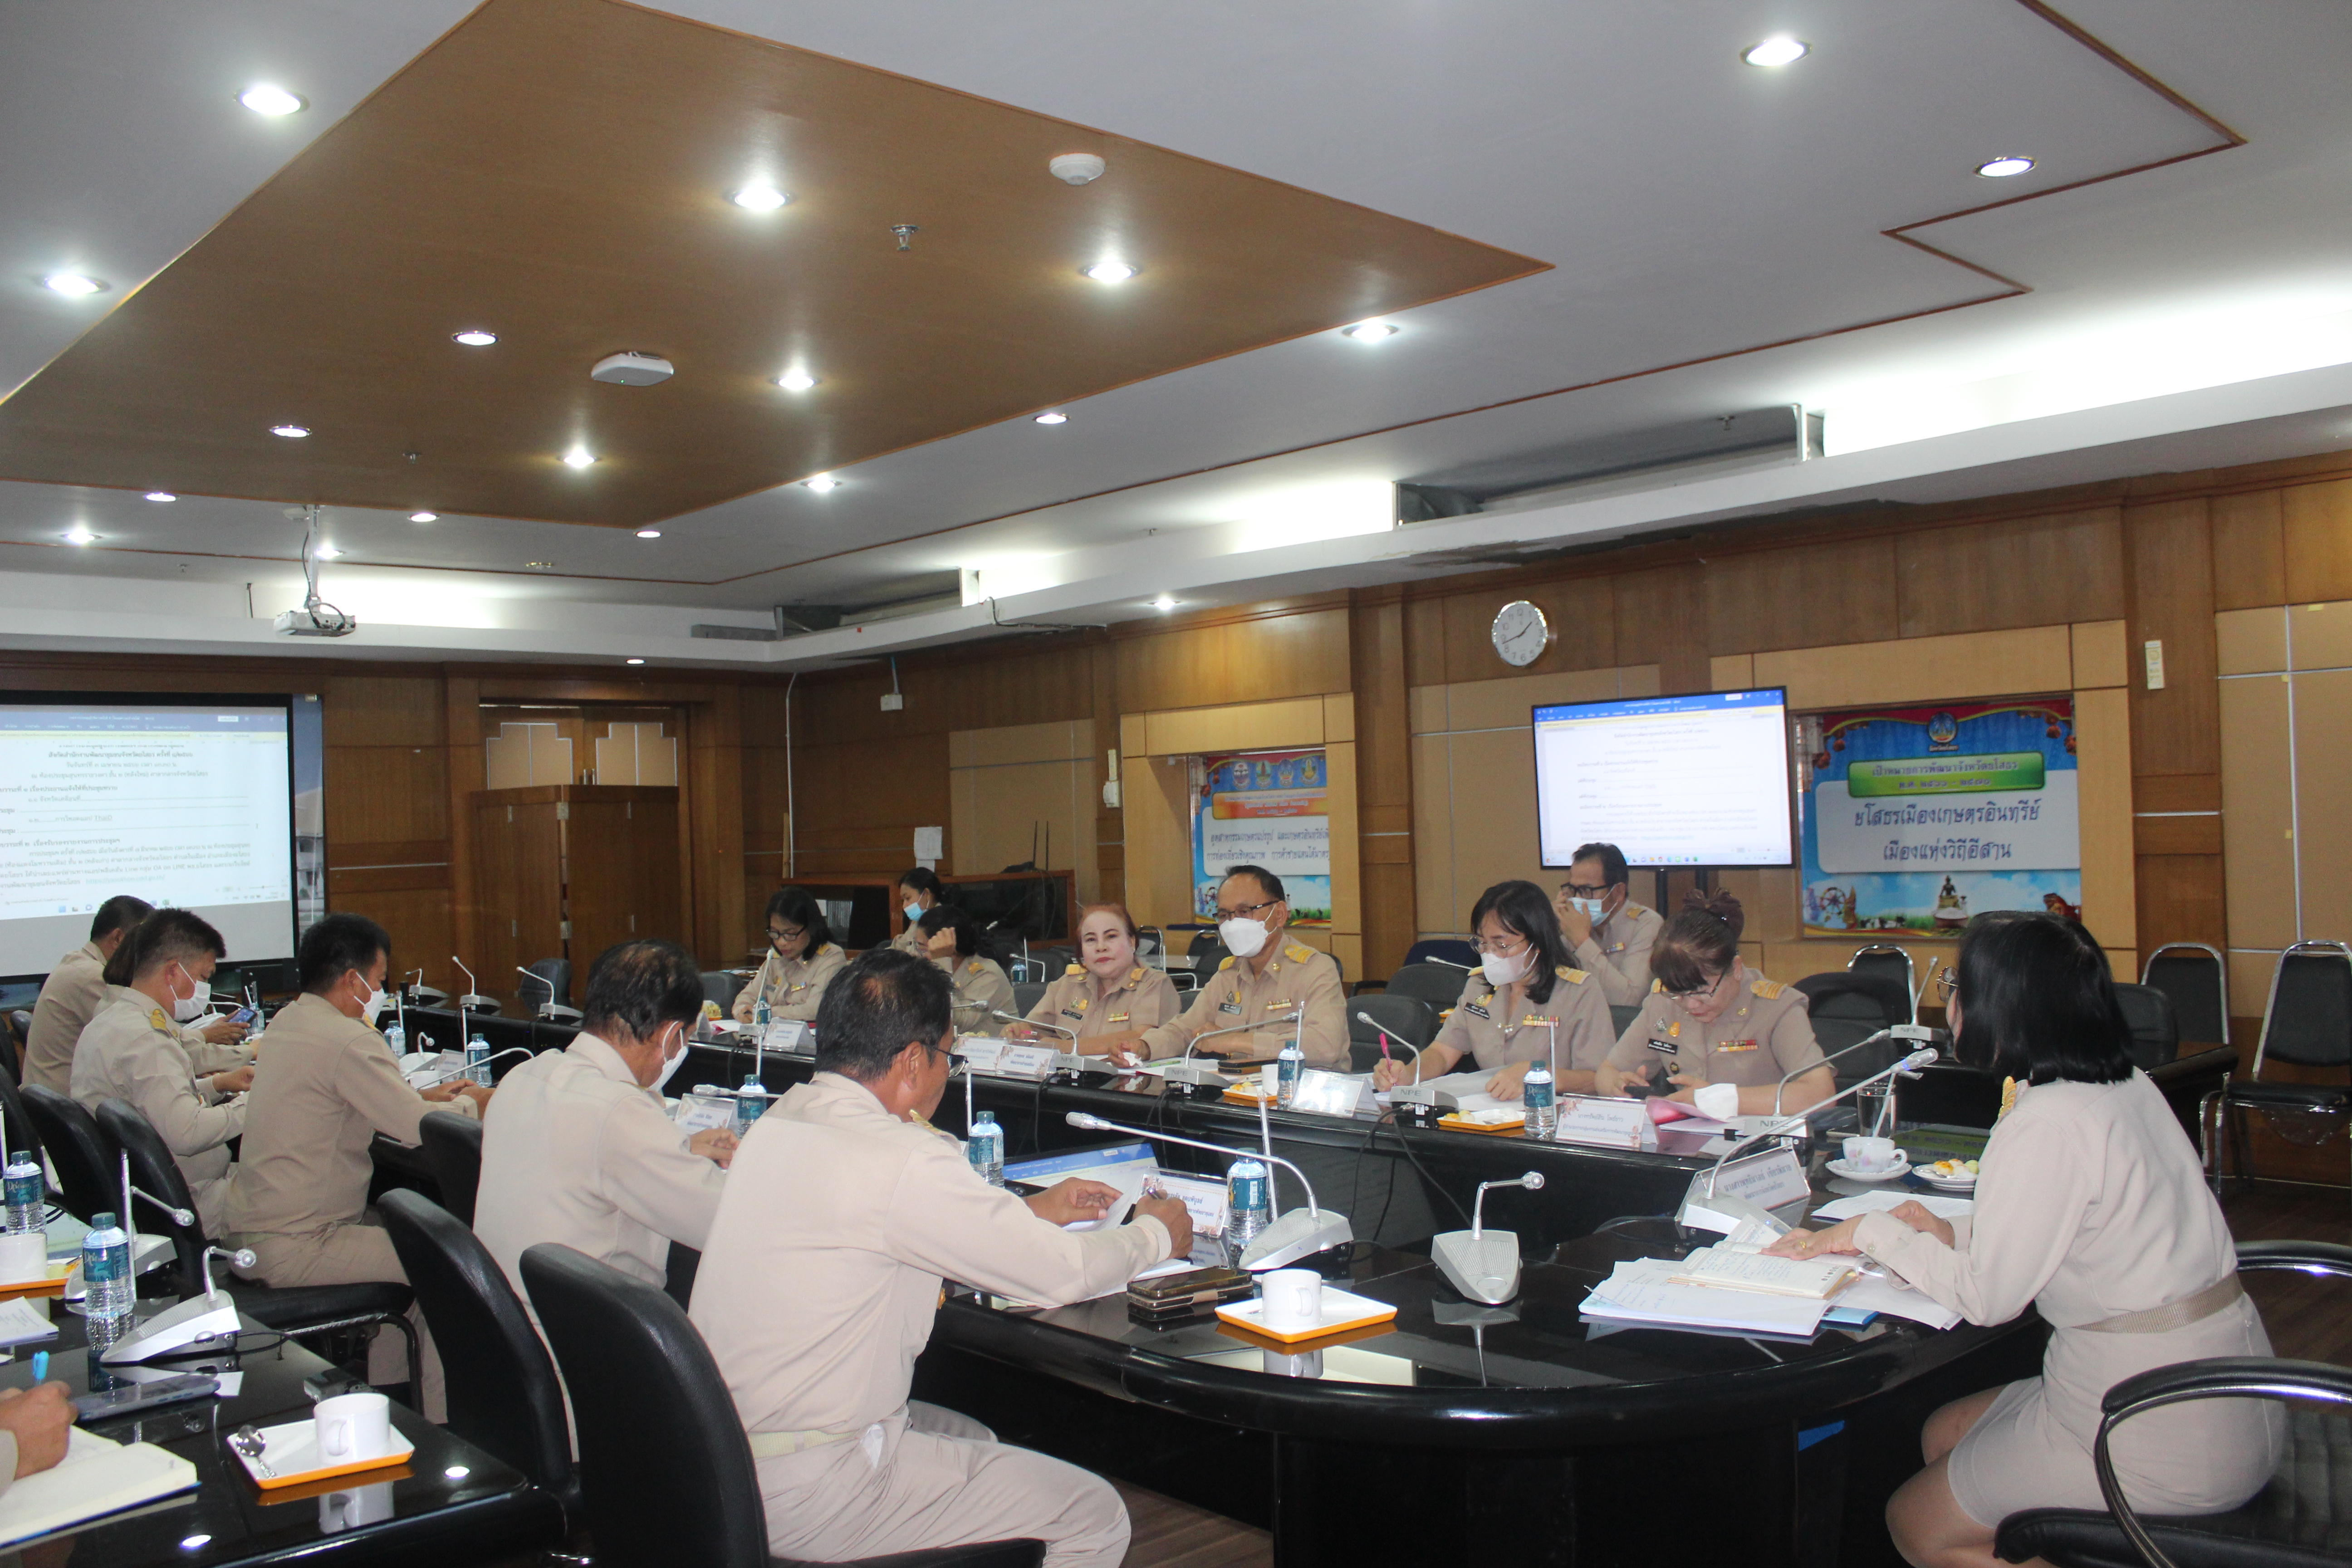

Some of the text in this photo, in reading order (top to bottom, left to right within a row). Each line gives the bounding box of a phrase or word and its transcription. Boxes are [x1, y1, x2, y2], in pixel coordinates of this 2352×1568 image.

[1855, 798, 2041, 827] ยโสธรเมืองเกษตรอินทรีย์
[1883, 838, 2012, 862] เมืองแห่งวิถีอีสาน
